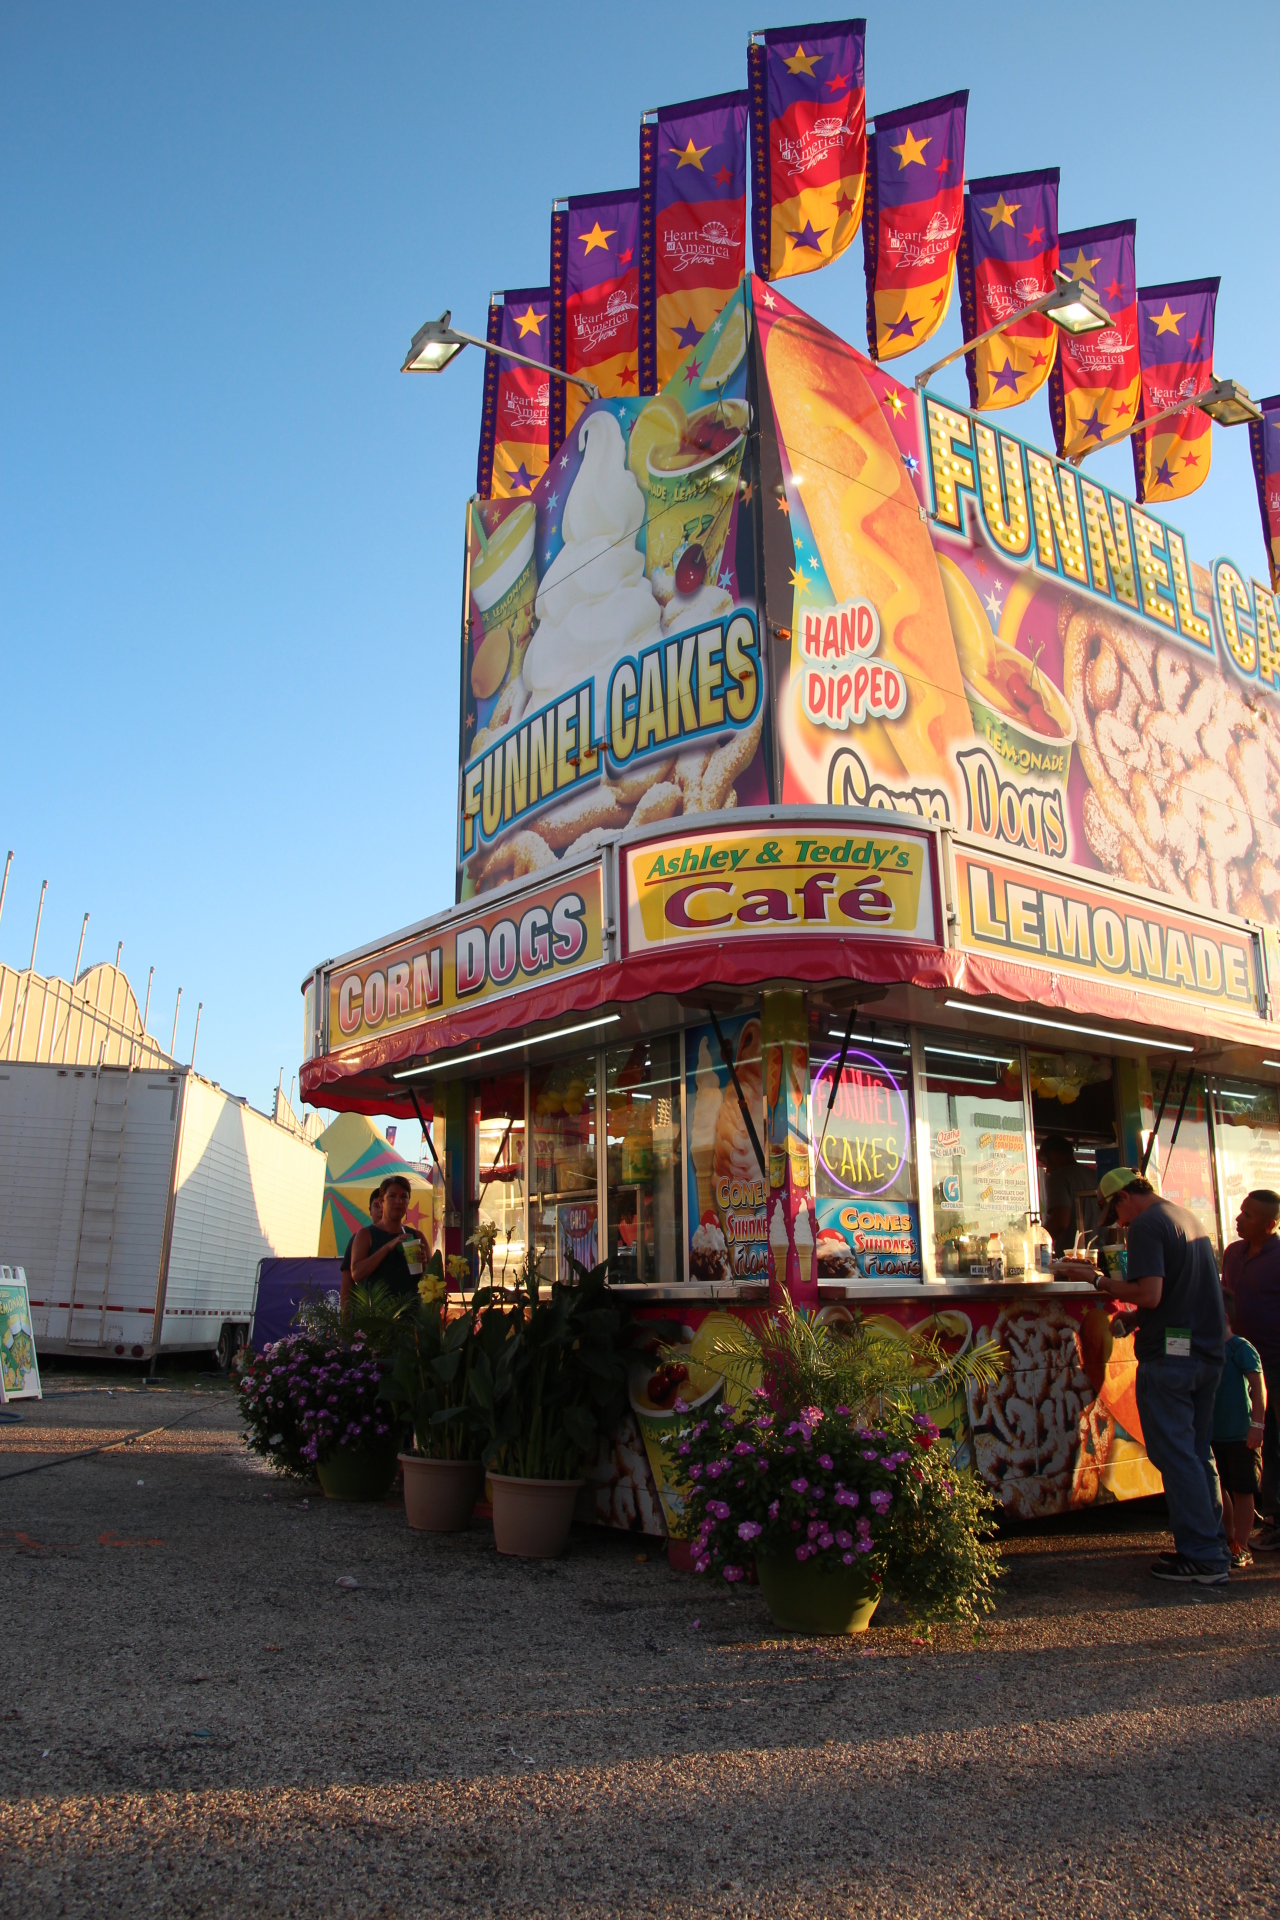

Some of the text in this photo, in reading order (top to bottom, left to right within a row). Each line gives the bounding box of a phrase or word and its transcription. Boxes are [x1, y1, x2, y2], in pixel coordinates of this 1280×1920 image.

[779, 130, 810, 152] Heart
[790, 135, 844, 162] America
[787, 149, 829, 176] Shows
[663, 230, 698, 242] Heart
[888, 228, 921, 243] Heart
[674, 241, 729, 257] America
[898, 240, 949, 258] America
[673, 251, 715, 272] Shows
[896, 253, 936, 268] Shows
[574, 313, 603, 326] Heart
[584, 313, 628, 336] America
[583, 328, 617, 352] Shows
[1066, 339, 1095, 353] Heart
[1077, 352, 1124, 363] America
[1077, 361, 1112, 373] Shows
[505, 391, 533, 406] Heart
[1149, 387, 1177, 398] Heart
[511, 415, 547, 426] Shows
[514, 405, 550, 417] Ameri
[925, 400, 1216, 656] FUNNEL
[492, 567, 530, 618] LEMONADE
[805, 605, 874, 659] HAND
[808, 665, 900, 720] DIPPED
[463, 613, 760, 853] FUNNEL CAKES
[985, 722, 1064, 773] LEMONADE
[956, 747, 1068, 859] Dogs
[646, 840, 910, 880] Ashley & Teddy's
[664, 872, 893, 928] Café
[967, 862, 1250, 1002] LEMONADE
[338, 891, 586, 1036] CORN DOGS
[816, 1067, 898, 1126] FUNNEL
[1249, 1111, 1280, 1124] FUNNEL CAKES
[937, 1129, 960, 1143] Ozarka
[994, 1141, 1024, 1151] CORN DOGS
[995, 1134, 1023, 1142] FOOTLONG
[822, 1135, 899, 1183] CAKES
[570, 1210, 587, 1230] COLD
[839, 1207, 912, 1232] CONES
[853, 1231, 917, 1256] SUNDAES
[864, 1255, 921, 1276] FLOATS
